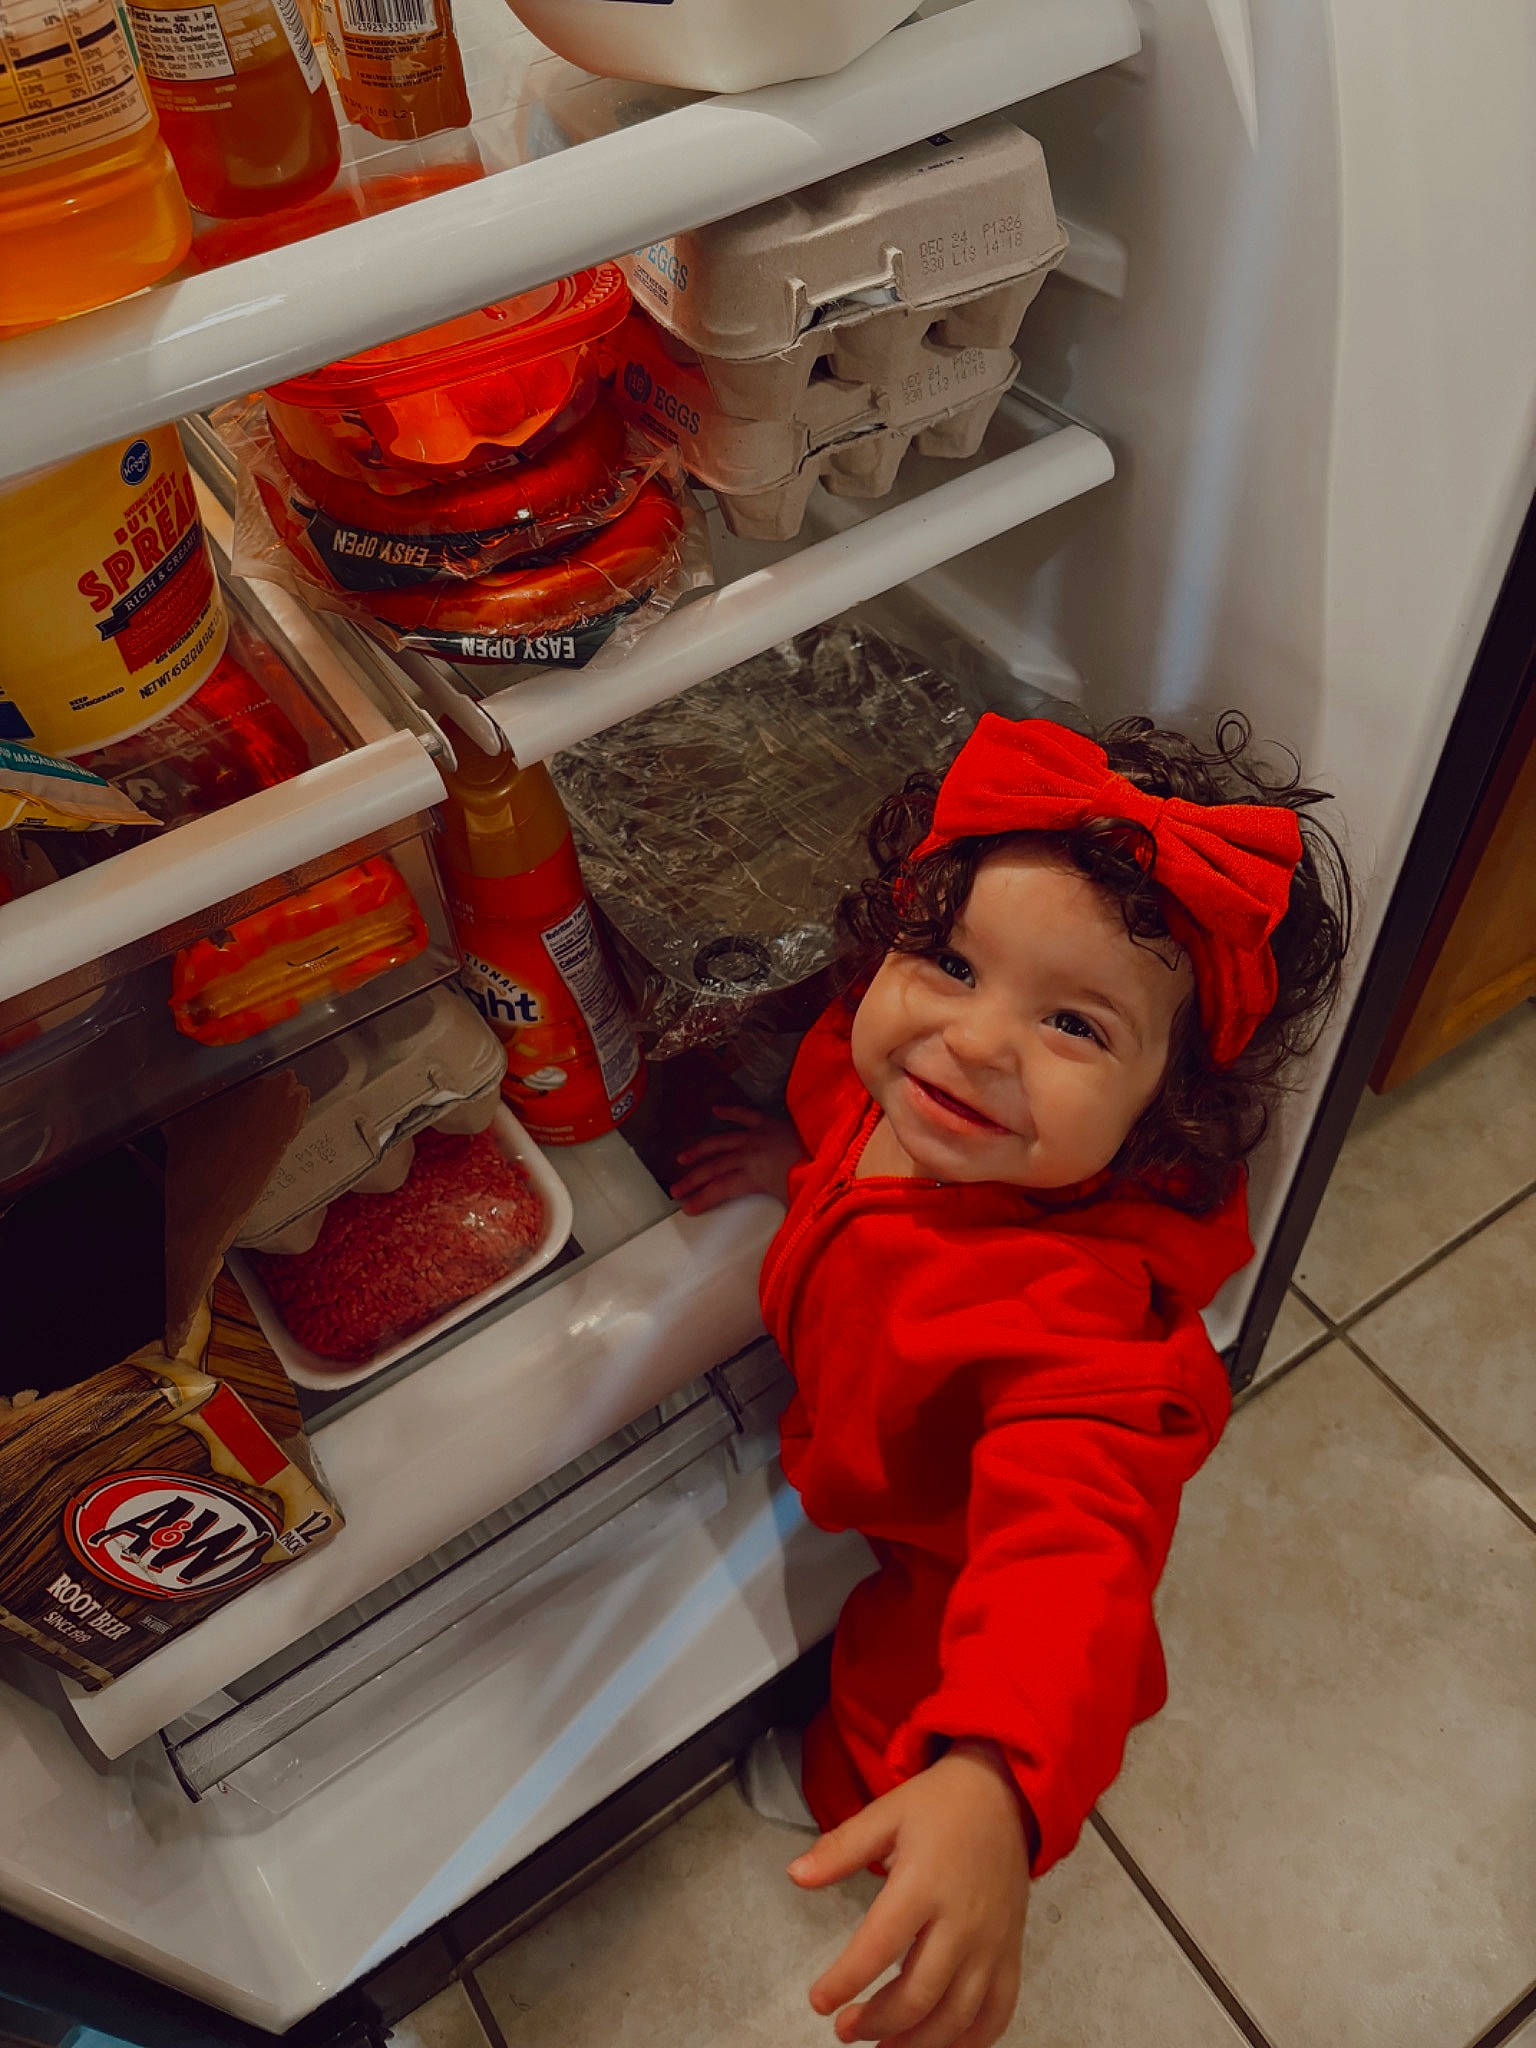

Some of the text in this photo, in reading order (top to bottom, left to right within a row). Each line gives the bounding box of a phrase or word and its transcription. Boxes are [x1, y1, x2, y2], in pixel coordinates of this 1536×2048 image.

[919, 237, 945, 258] DEC
[951, 231, 968, 248] 24
[647, 244, 688, 292] EGGS
[653, 384, 700, 435] EGGS
[113, 471, 177, 546] BUTTERY
[333, 529, 430, 568] EASY OPEN
[123, 579, 157, 612] RICH
[461, 635, 576, 660] EASY OPEN
[139, 682, 157, 699] NET
[156, 670, 171, 688] WT
[465, 951, 518, 993] TIONAL
[87, 1495, 273, 1585] A&W
[295, 1511, 332, 1544] 12
[43, 1611, 78, 1635] SINCE
[45, 1571, 103, 1620] ROOT
[87, 1610, 132, 1641] BEER
